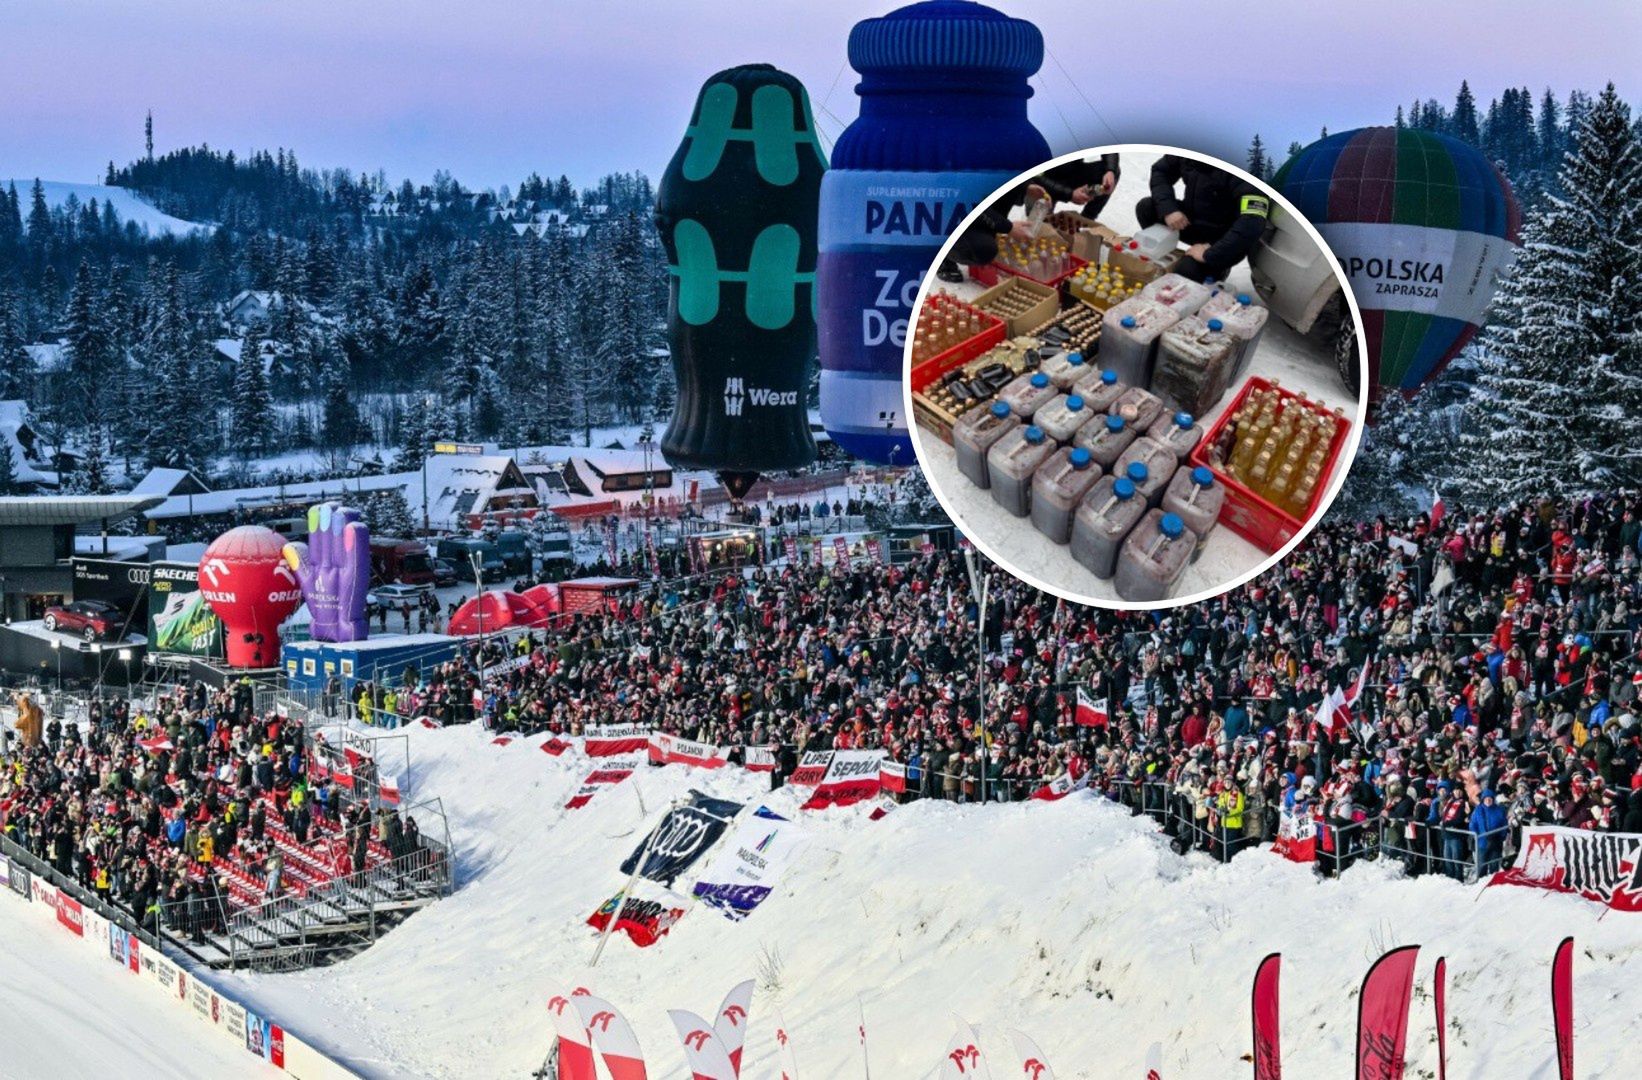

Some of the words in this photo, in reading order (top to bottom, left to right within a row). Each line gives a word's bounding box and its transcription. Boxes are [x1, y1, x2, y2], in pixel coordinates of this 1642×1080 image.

[866, 187, 928, 197] SUPLEMENT
[929, 187, 960, 198] DIETY
[866, 201, 977, 236] PANA
[1375, 283, 1439, 298] ZAPRASZA
[748, 388, 797, 406] Wera
